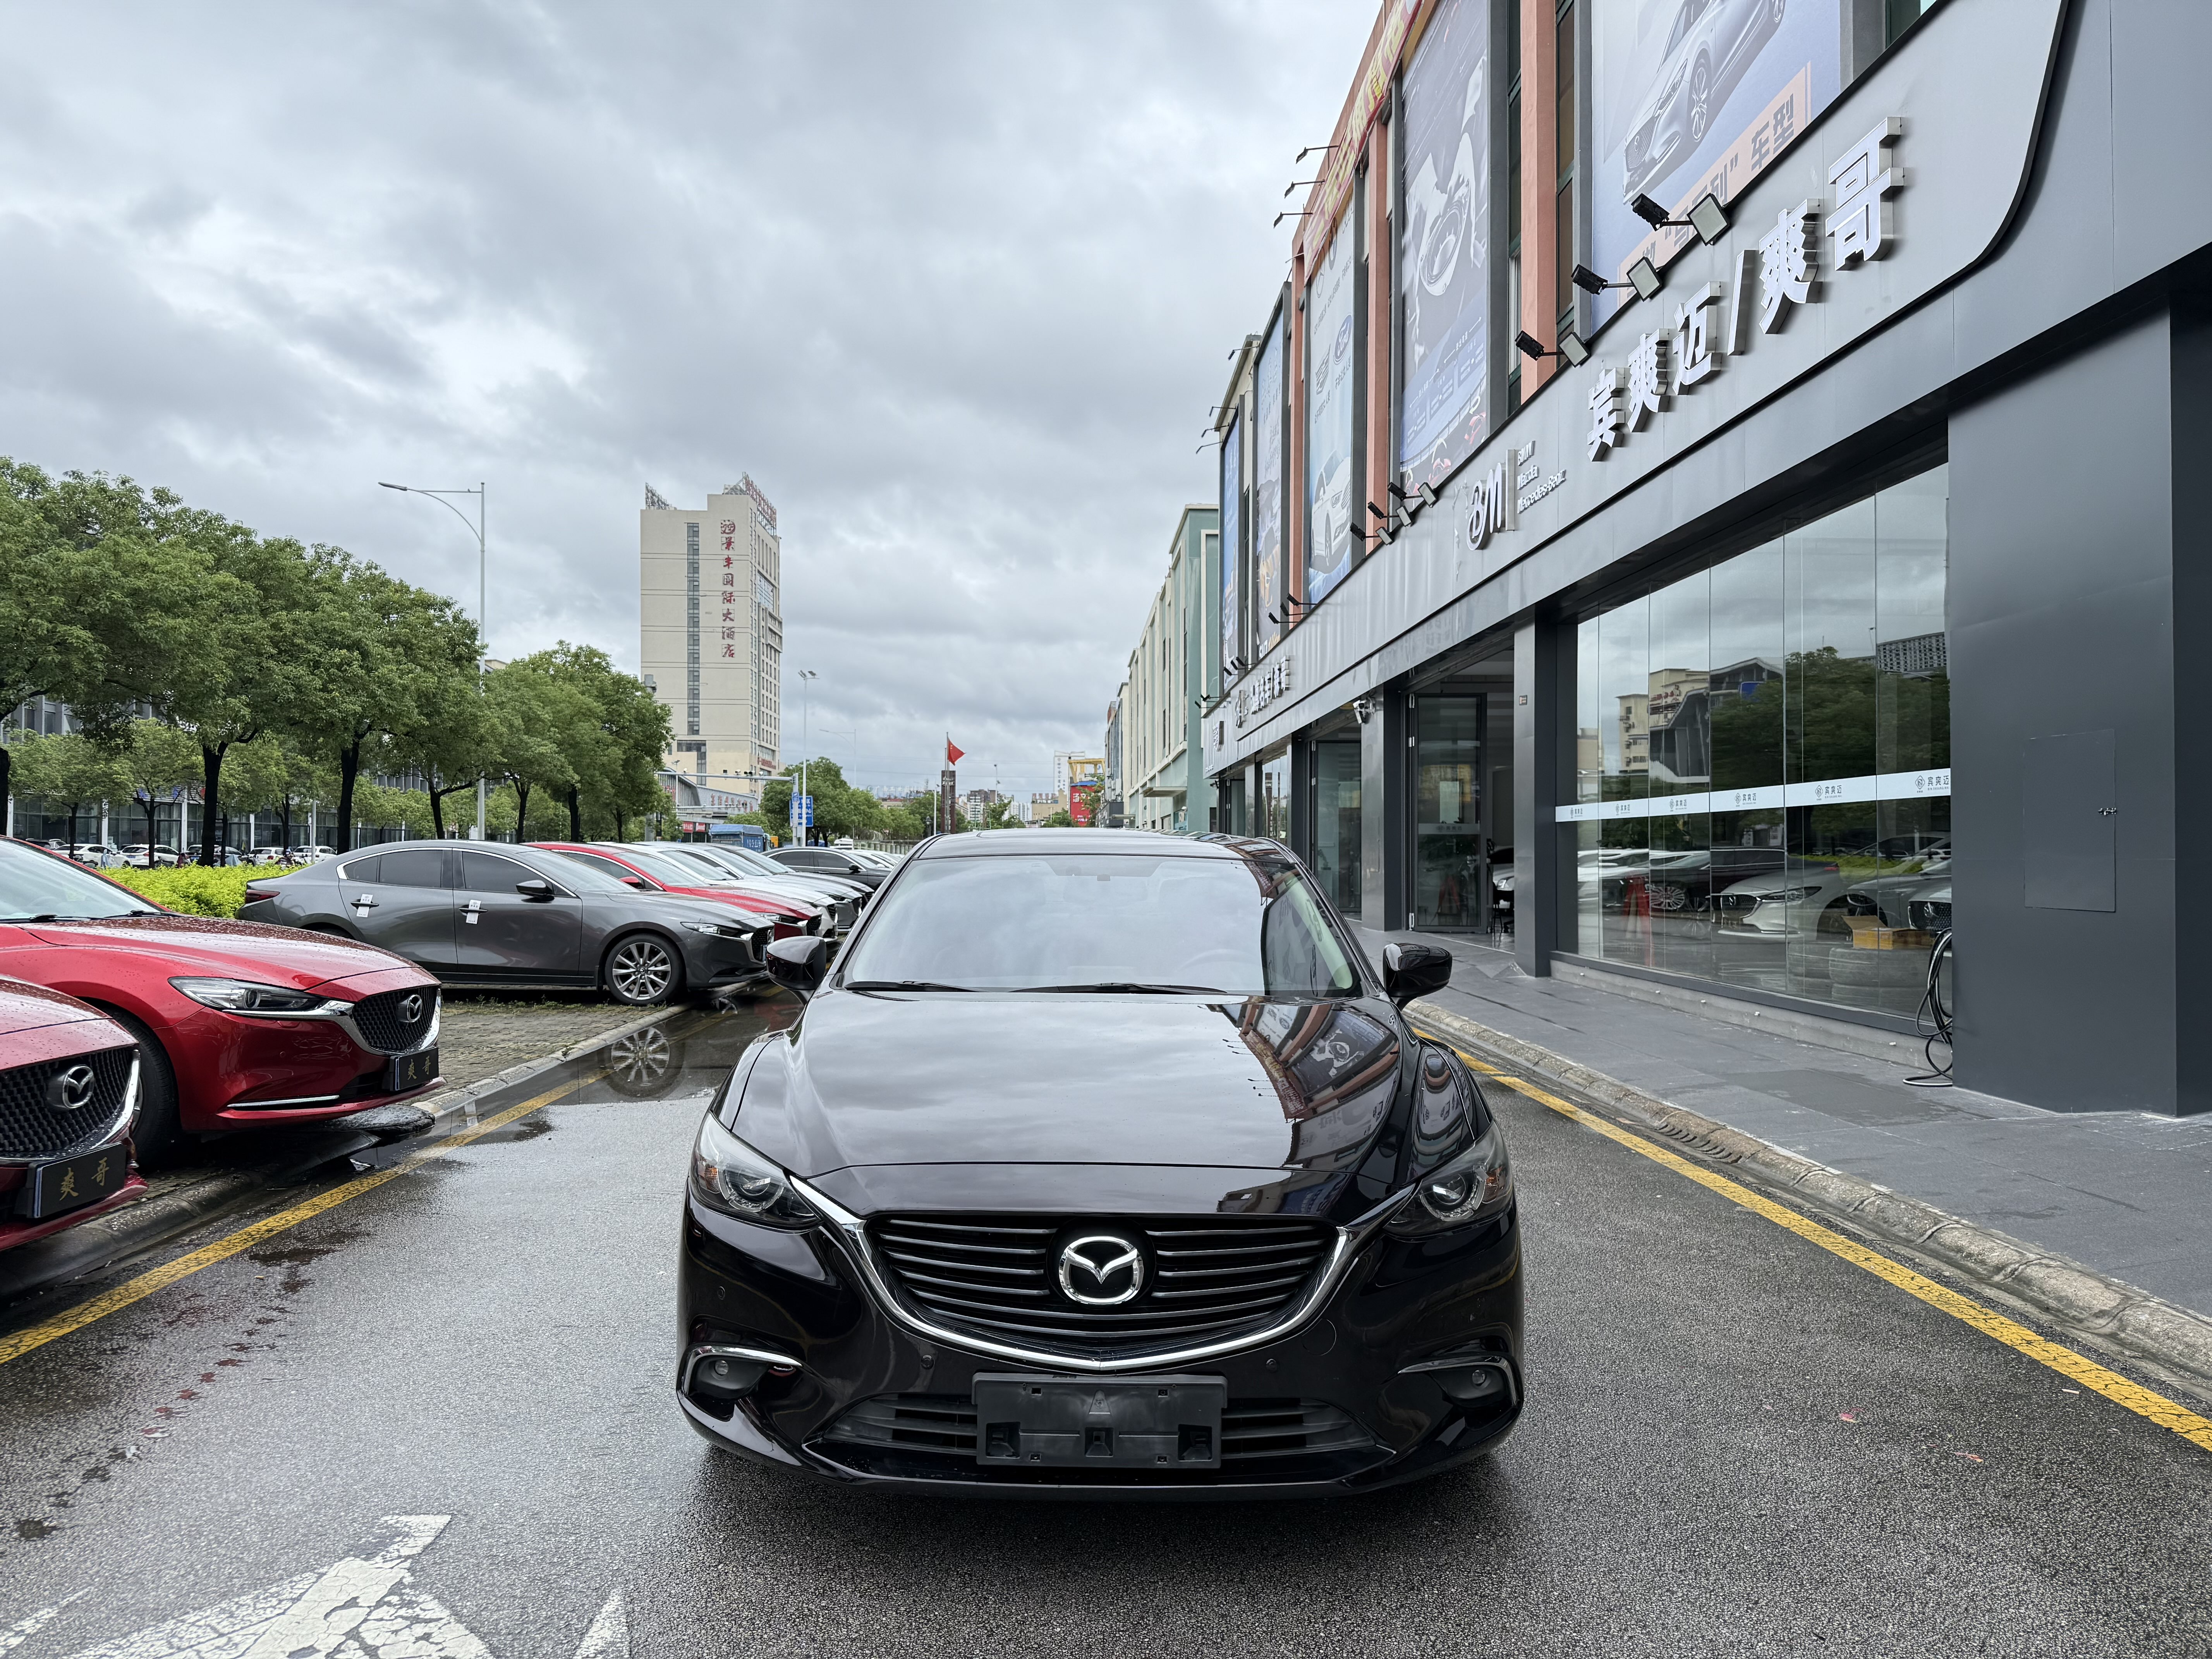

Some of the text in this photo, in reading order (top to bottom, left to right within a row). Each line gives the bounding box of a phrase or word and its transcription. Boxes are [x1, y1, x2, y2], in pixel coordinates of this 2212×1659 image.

[1750, 93, 1794, 170] 车型
[1518, 440, 1535, 466] BMW
[1517, 465, 1539, 490] Mazda
[1517, 469, 1566, 514] Mercedes-Benz
[1825, 785, 1842, 795] 宾爽迈
[1928, 775, 1949, 786] 宾爽迈
[1743, 793, 1756, 802] 宾爽迈
[407, 1056, 431, 1080] 爽哥
[59, 1157, 110, 1201] 爽哥
